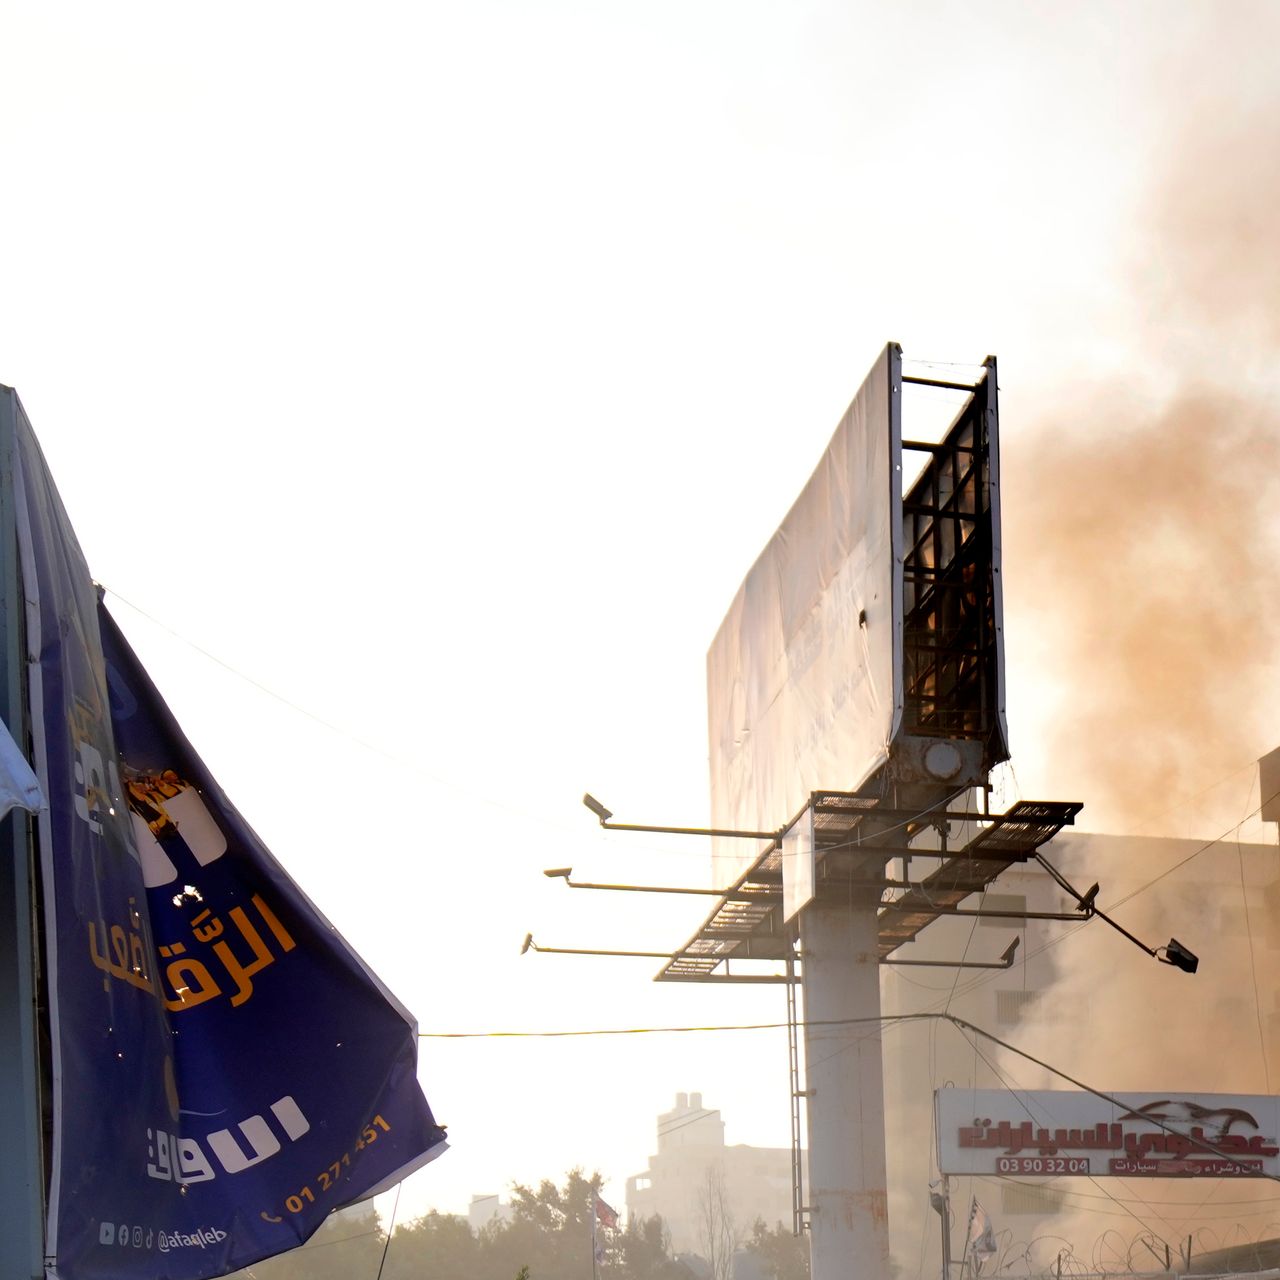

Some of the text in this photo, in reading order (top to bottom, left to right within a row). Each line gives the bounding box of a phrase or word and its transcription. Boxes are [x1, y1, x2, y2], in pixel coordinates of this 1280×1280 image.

[959, 1117, 1123, 1157] للسيارات
[1000, 1158, 1089, 1173] 03 90 32 04
[285, 1186, 316, 1214] 01
